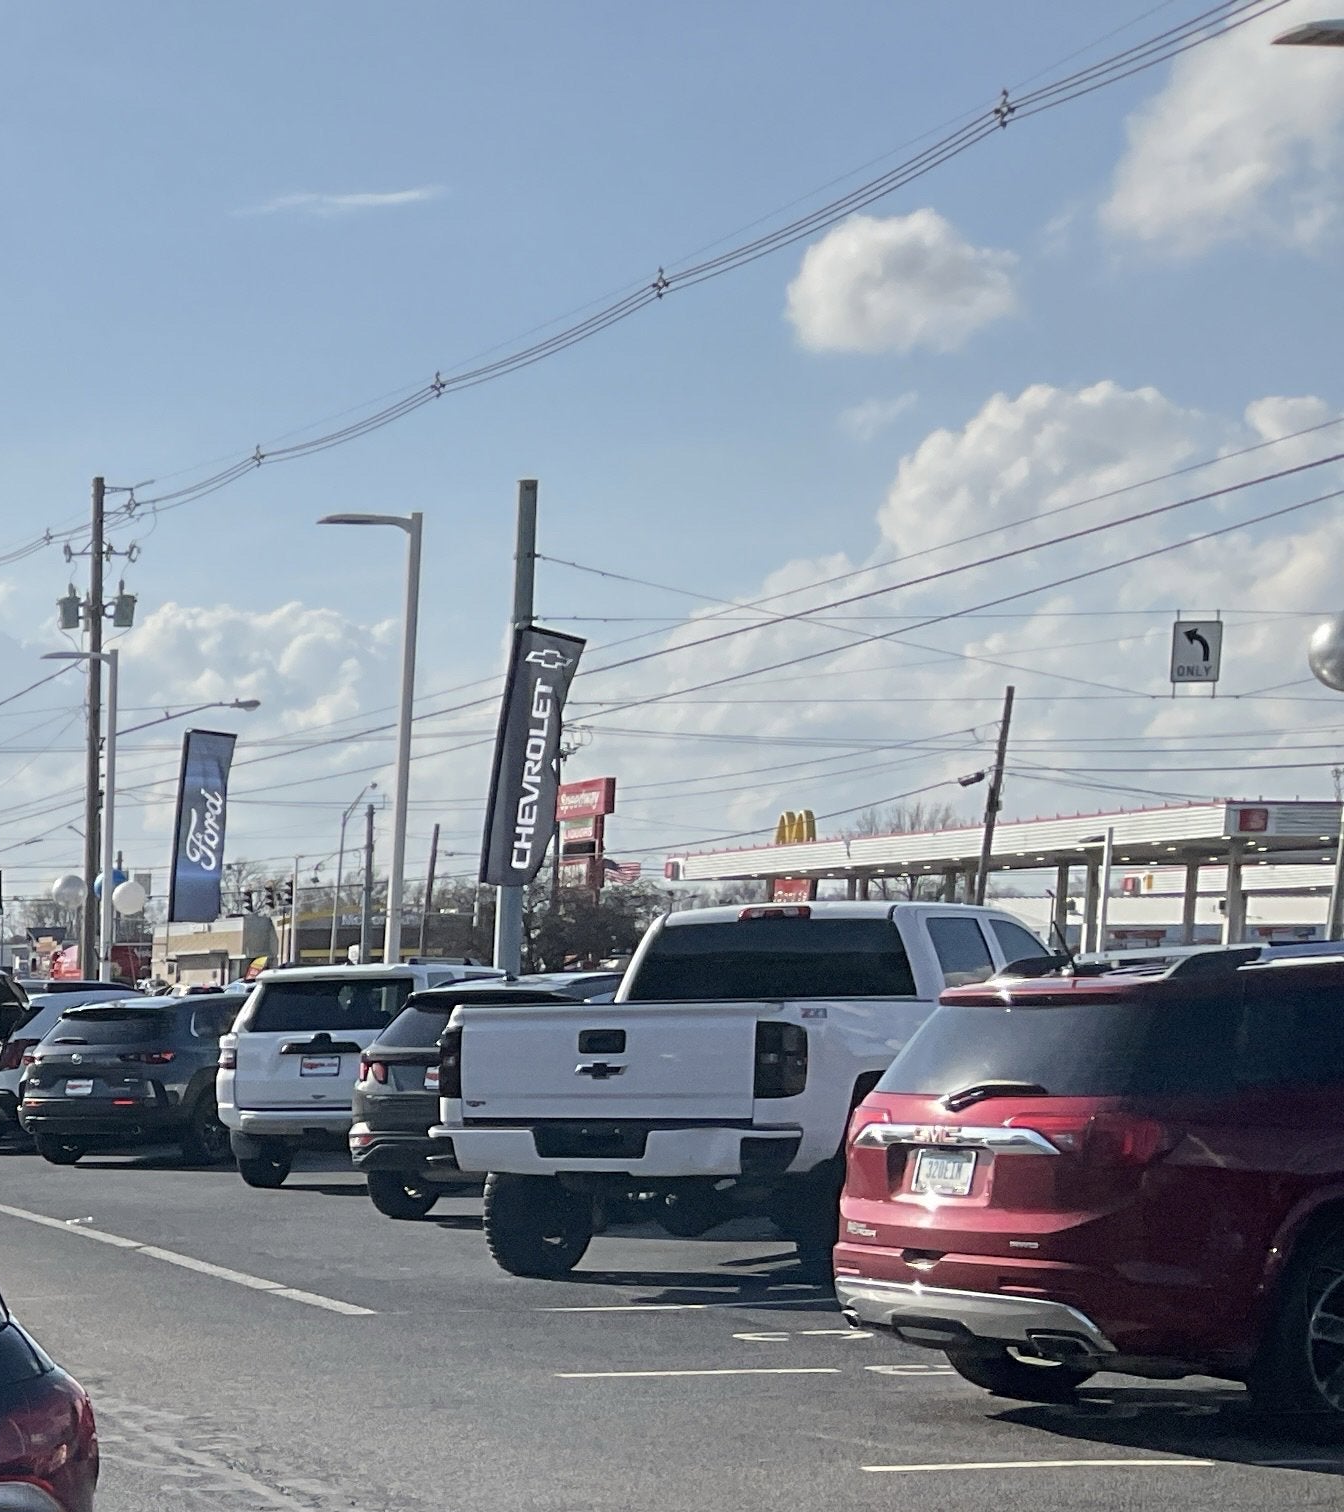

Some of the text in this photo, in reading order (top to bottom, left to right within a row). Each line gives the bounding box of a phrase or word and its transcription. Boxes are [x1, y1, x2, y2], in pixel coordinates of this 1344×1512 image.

[1176, 664, 1213, 677] ONLY
[511, 677, 553, 870] CHEVROLET
[186, 788, 223, 871] Ford
[913, 1126, 962, 1143] GMC
